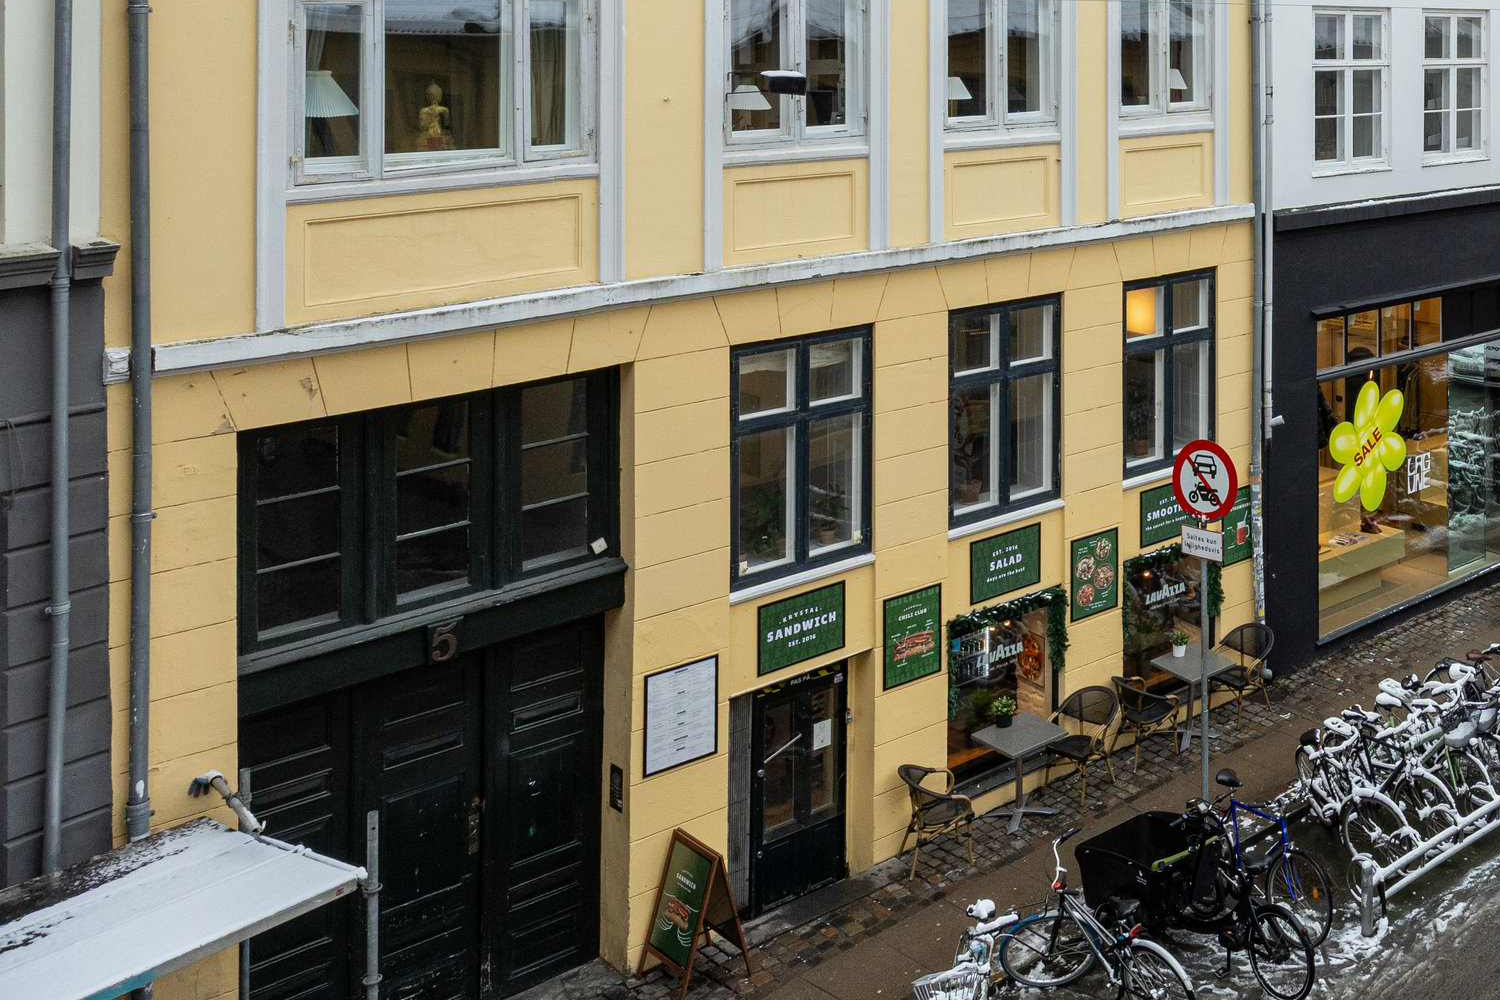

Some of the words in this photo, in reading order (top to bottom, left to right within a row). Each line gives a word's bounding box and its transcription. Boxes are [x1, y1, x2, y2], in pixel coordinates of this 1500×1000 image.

[1354, 427, 1383, 467] SALE
[1186, 532, 1204, 542] Saltes
[1207, 537, 1217, 545] kun
[992, 549, 1004, 557] EST.
[990, 553, 1022, 572] SALAD
[1146, 581, 1186, 606] LAVAZZA
[898, 612, 914, 621] CHILI
[914, 608, 927, 616] CLUB
[767, 611, 837, 643] SANDWICH
[432, 622, 457, 661] 5
[788, 638, 801, 648] EST.
[802, 634, 817, 644] 2016
[976, 641, 1024, 668] LAVAZZA
[790, 677, 801, 686] PAS
[676, 872, 697, 890] SANDWICH
